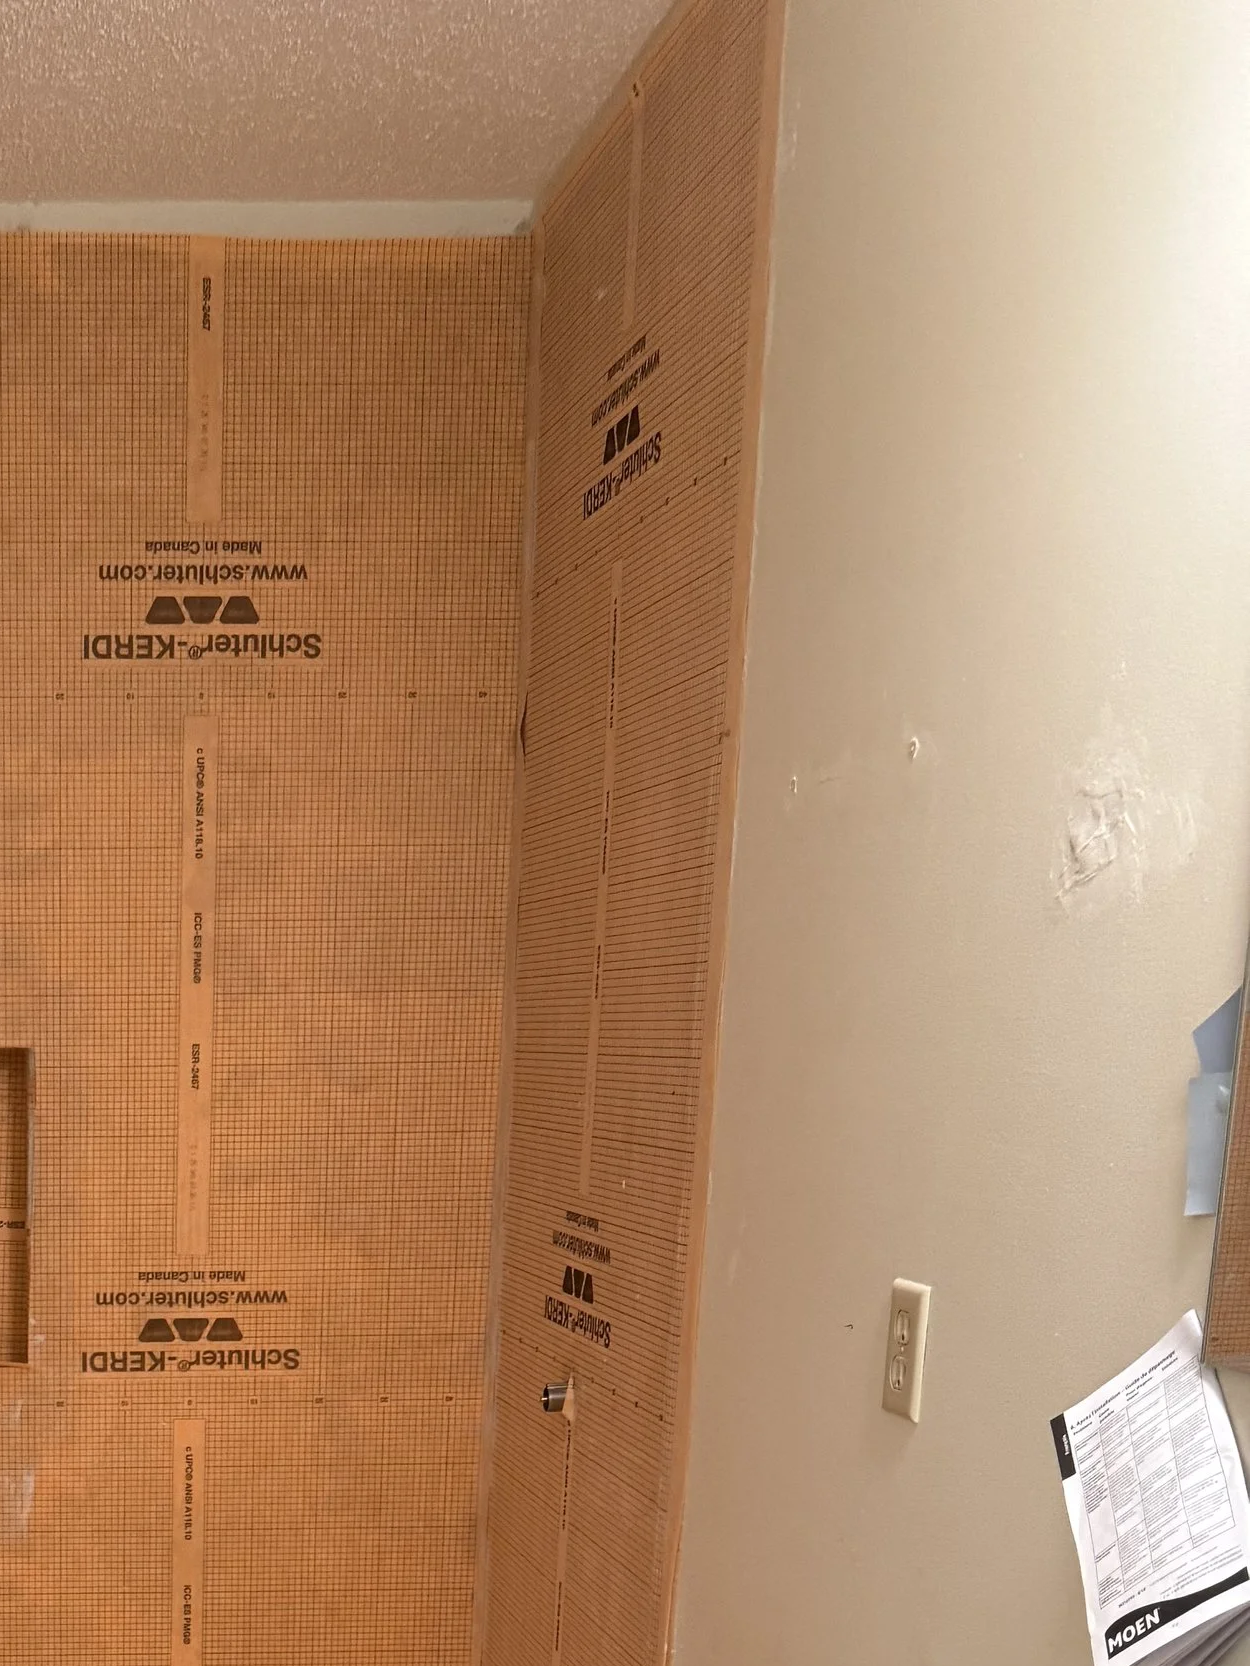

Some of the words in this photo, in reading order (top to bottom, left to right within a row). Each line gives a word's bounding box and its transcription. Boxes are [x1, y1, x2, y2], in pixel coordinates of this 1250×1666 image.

[145, 541, 201, 555] Canada
[205, 540, 218, 553] in
[222, 540, 262, 554] Made
[98, 564, 309, 585] www.schluter.com
[83, 633, 322, 660] Schluter®-KERDI
[195, 791, 205, 818] ANSI
[194, 819, 204, 860] A118.10
[138, 1271, 188, 1283] Canada
[193, 1271, 205, 1281] in
[209, 1270, 246, 1282] Made
[95, 1290, 288, 1308] www.schluter.com
[81, 1348, 300, 1373] Schluter®-KERDI
[1108, 1608, 1160, 1653] MOEN
